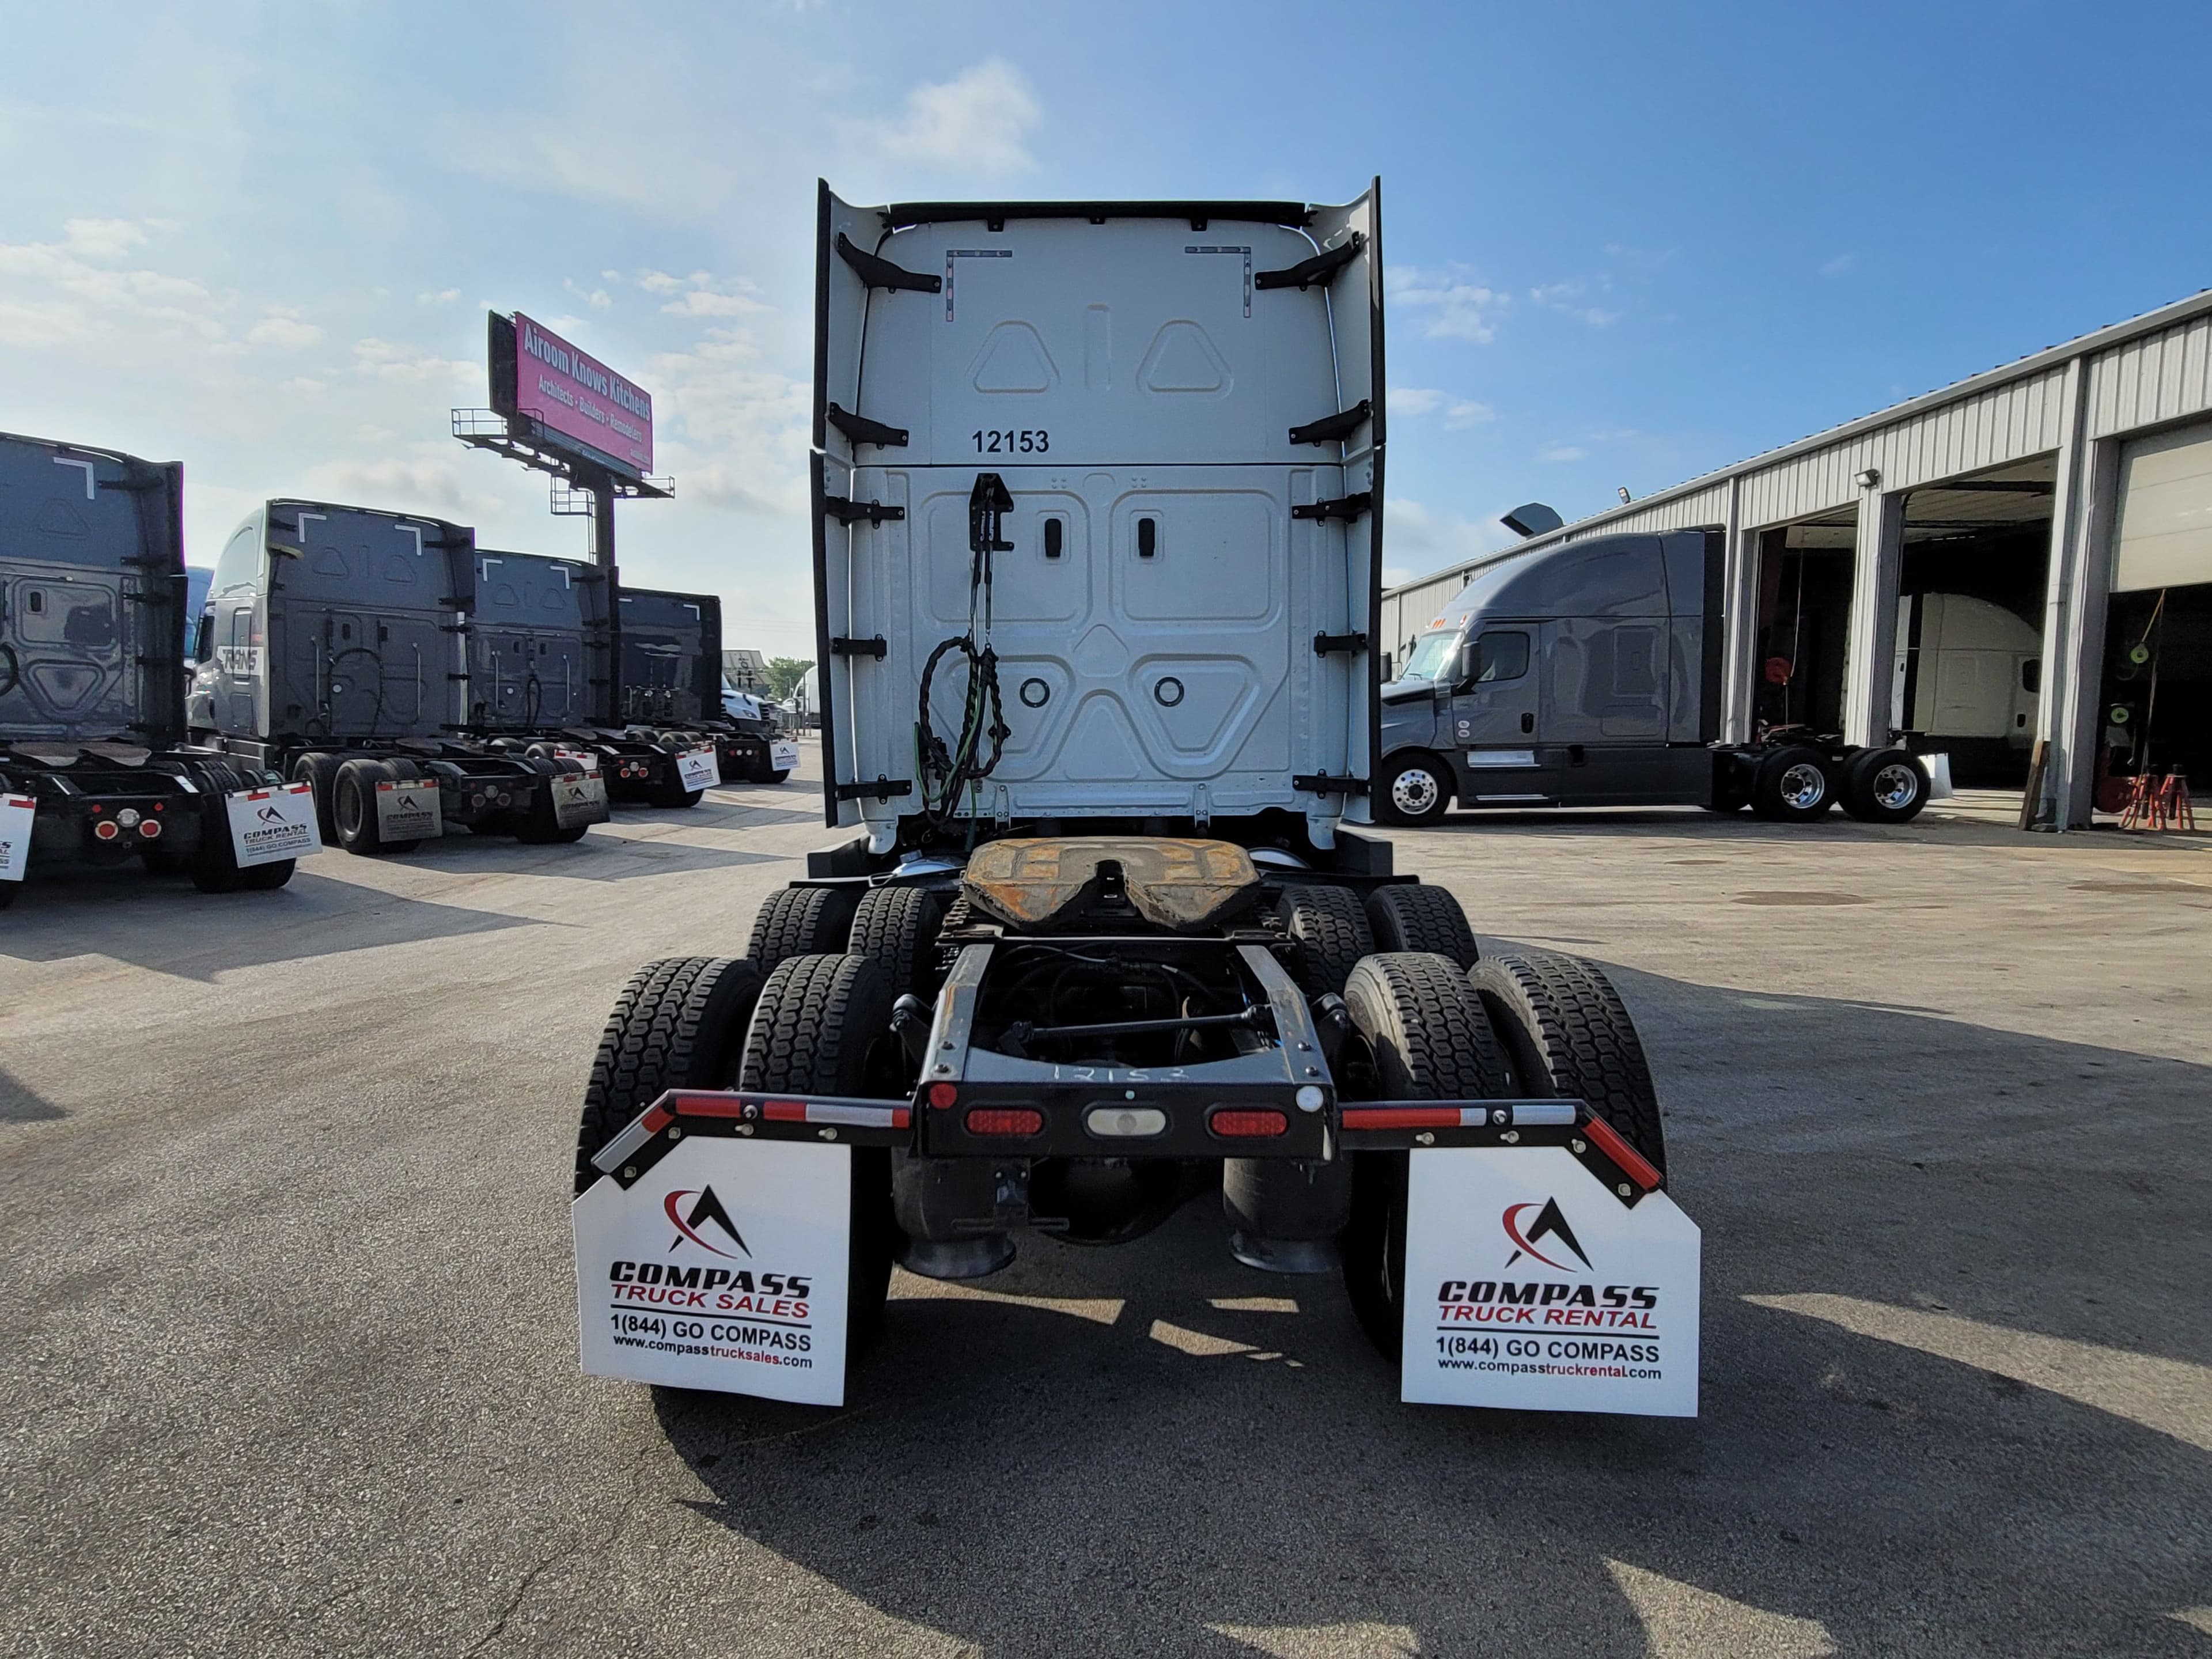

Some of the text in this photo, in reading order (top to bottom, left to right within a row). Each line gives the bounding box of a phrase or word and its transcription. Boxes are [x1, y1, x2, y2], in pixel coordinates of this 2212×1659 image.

[524, 323, 650, 421] Airoom Knows Kitchens
[539, 374, 574, 407] Architects
[579, 397, 605, 423] Builders
[972, 430, 1049, 453] 12153
[222, 649, 258, 670] TRANS
[244, 823, 307, 839] COMPASS
[245, 829, 309, 844] TRUCK RENTAL
[278, 838, 310, 847] COMPASS
[1054, 1065, 1190, 1082] 12153
[609, 1261, 813, 1298] COMPASS
[611, 1284, 809, 1319] TRUCK SALES
[1438, 1281, 1660, 1309] COMPASS
[1439, 1305, 1657, 1329] TRUCK RENTAL
[611, 1314, 812, 1352] 1(844) GO COMPASS
[613, 1335, 813, 1369] www.compasstrucksales.com
[1436, 1336, 1660, 1363] 1(844) GO COMPASS
[1438, 1358, 1662, 1380] www.compasstruckrental.com
